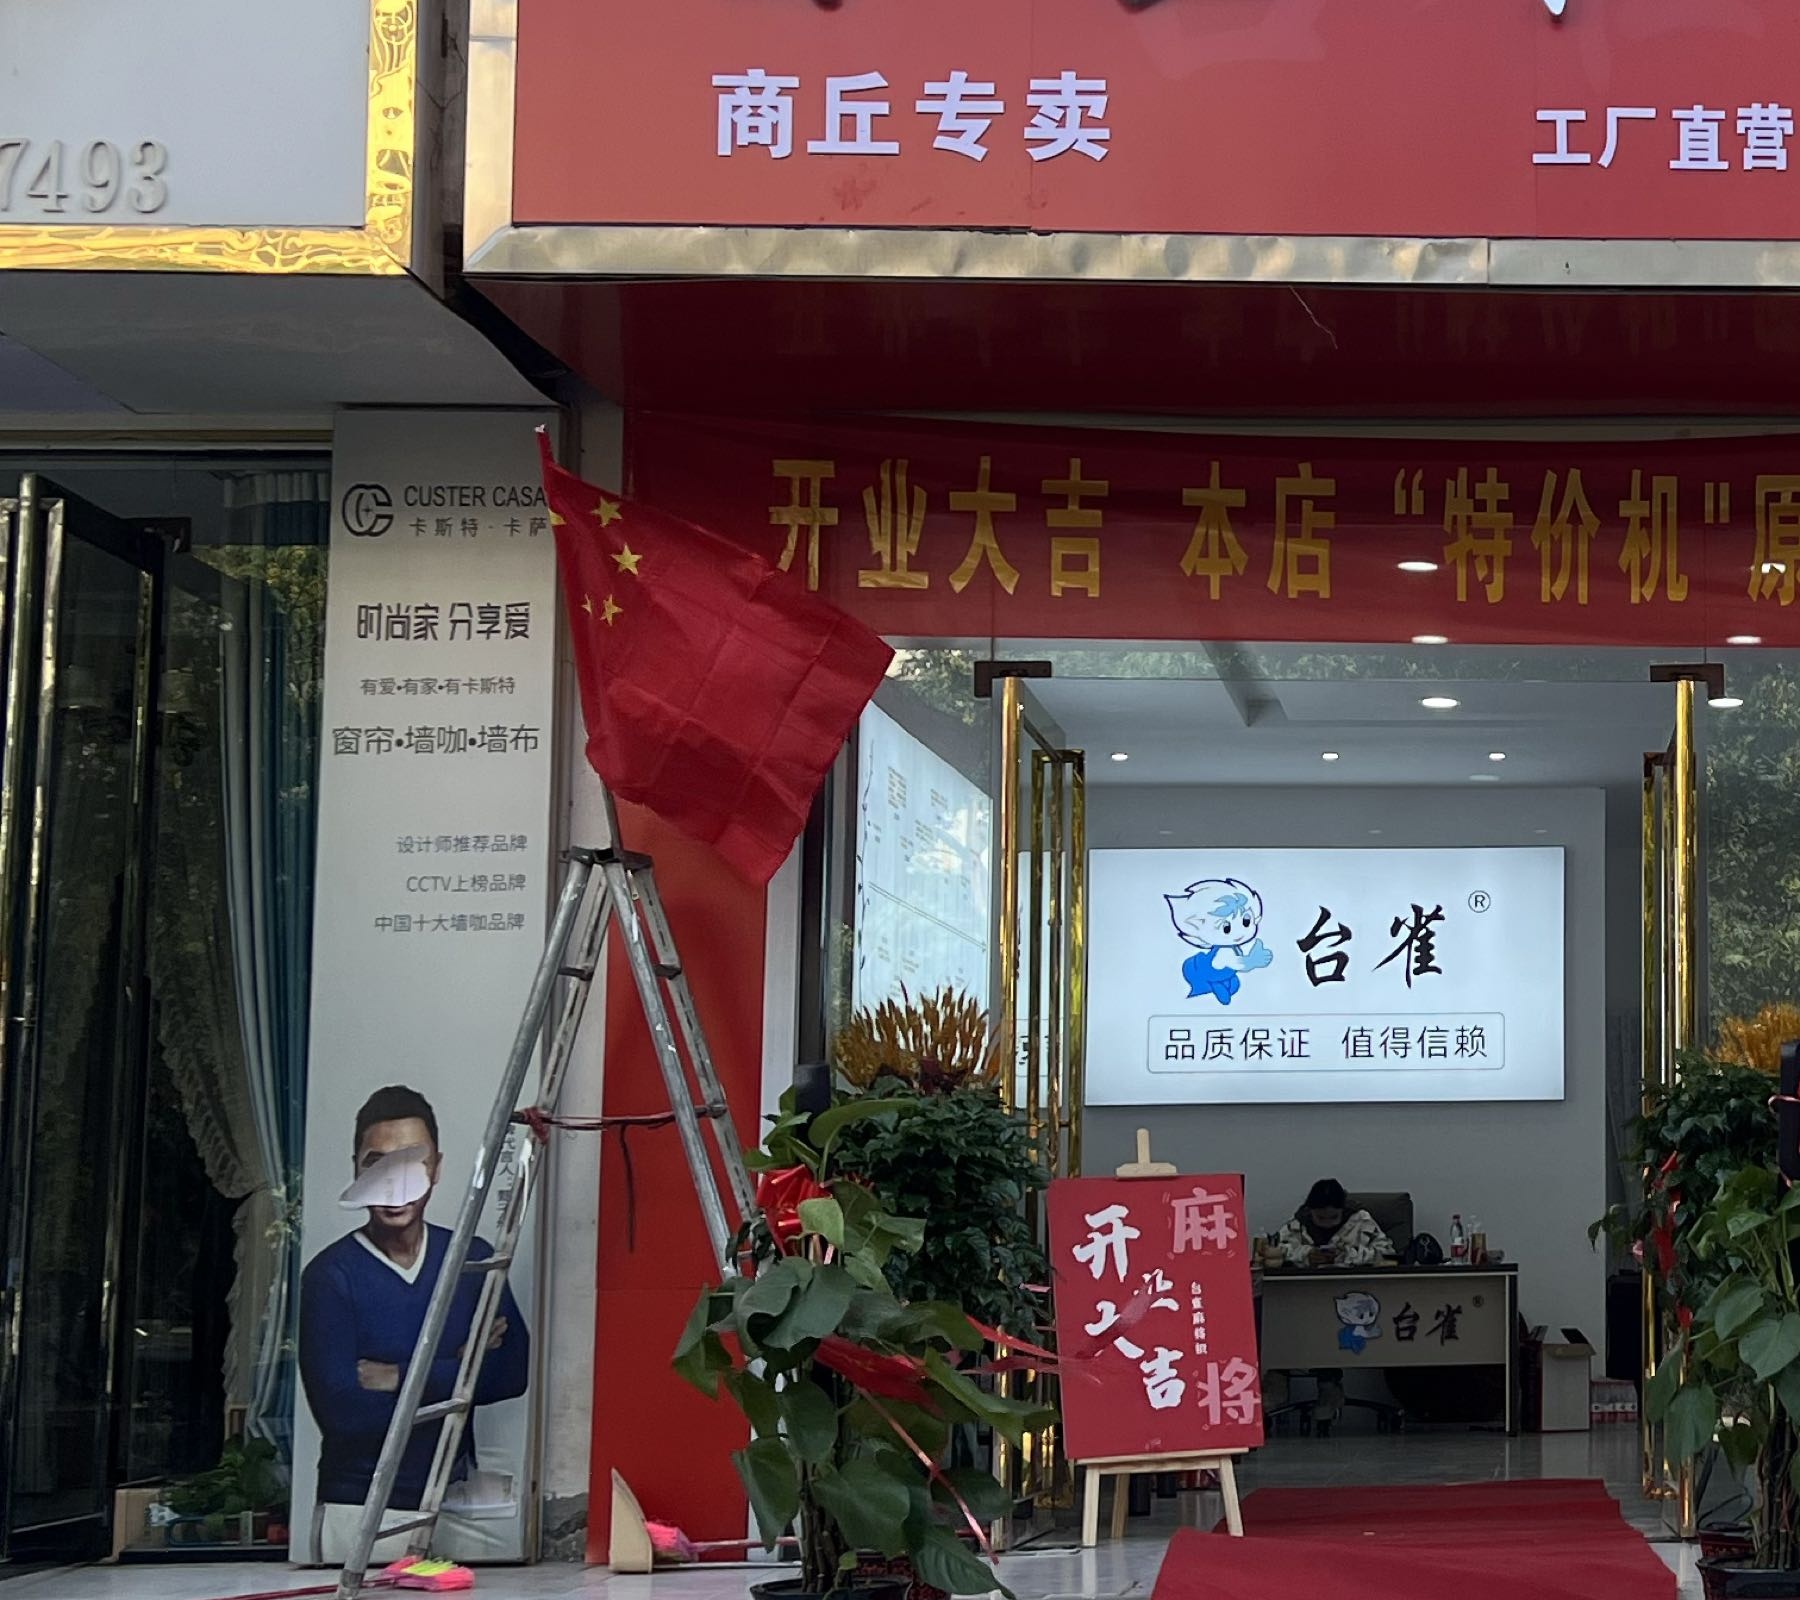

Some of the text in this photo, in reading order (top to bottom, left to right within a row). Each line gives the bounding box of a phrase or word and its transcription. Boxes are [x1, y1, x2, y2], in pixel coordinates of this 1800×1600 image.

[711, 69, 1111, 161] 商丘专卖
[404, 485, 547, 507] CUSTER CASA
[768, 456, 1109, 598] 开业大吉
[1180, 460, 1337, 601] 本店
[357, 601, 530, 641] 时尚家 分享爱
[396, 834, 528, 855] 设计师推荐品牌
[406, 873, 527, 893] CCTV上榜品牌
[374, 913, 526, 933] 中国十大墙咖品牌
[1296, 903, 1447, 989] 台雀
[1163, 1025, 1488, 1061] 品质保证 值得信赖
[1392, 1302, 1465, 1346] 台雀
